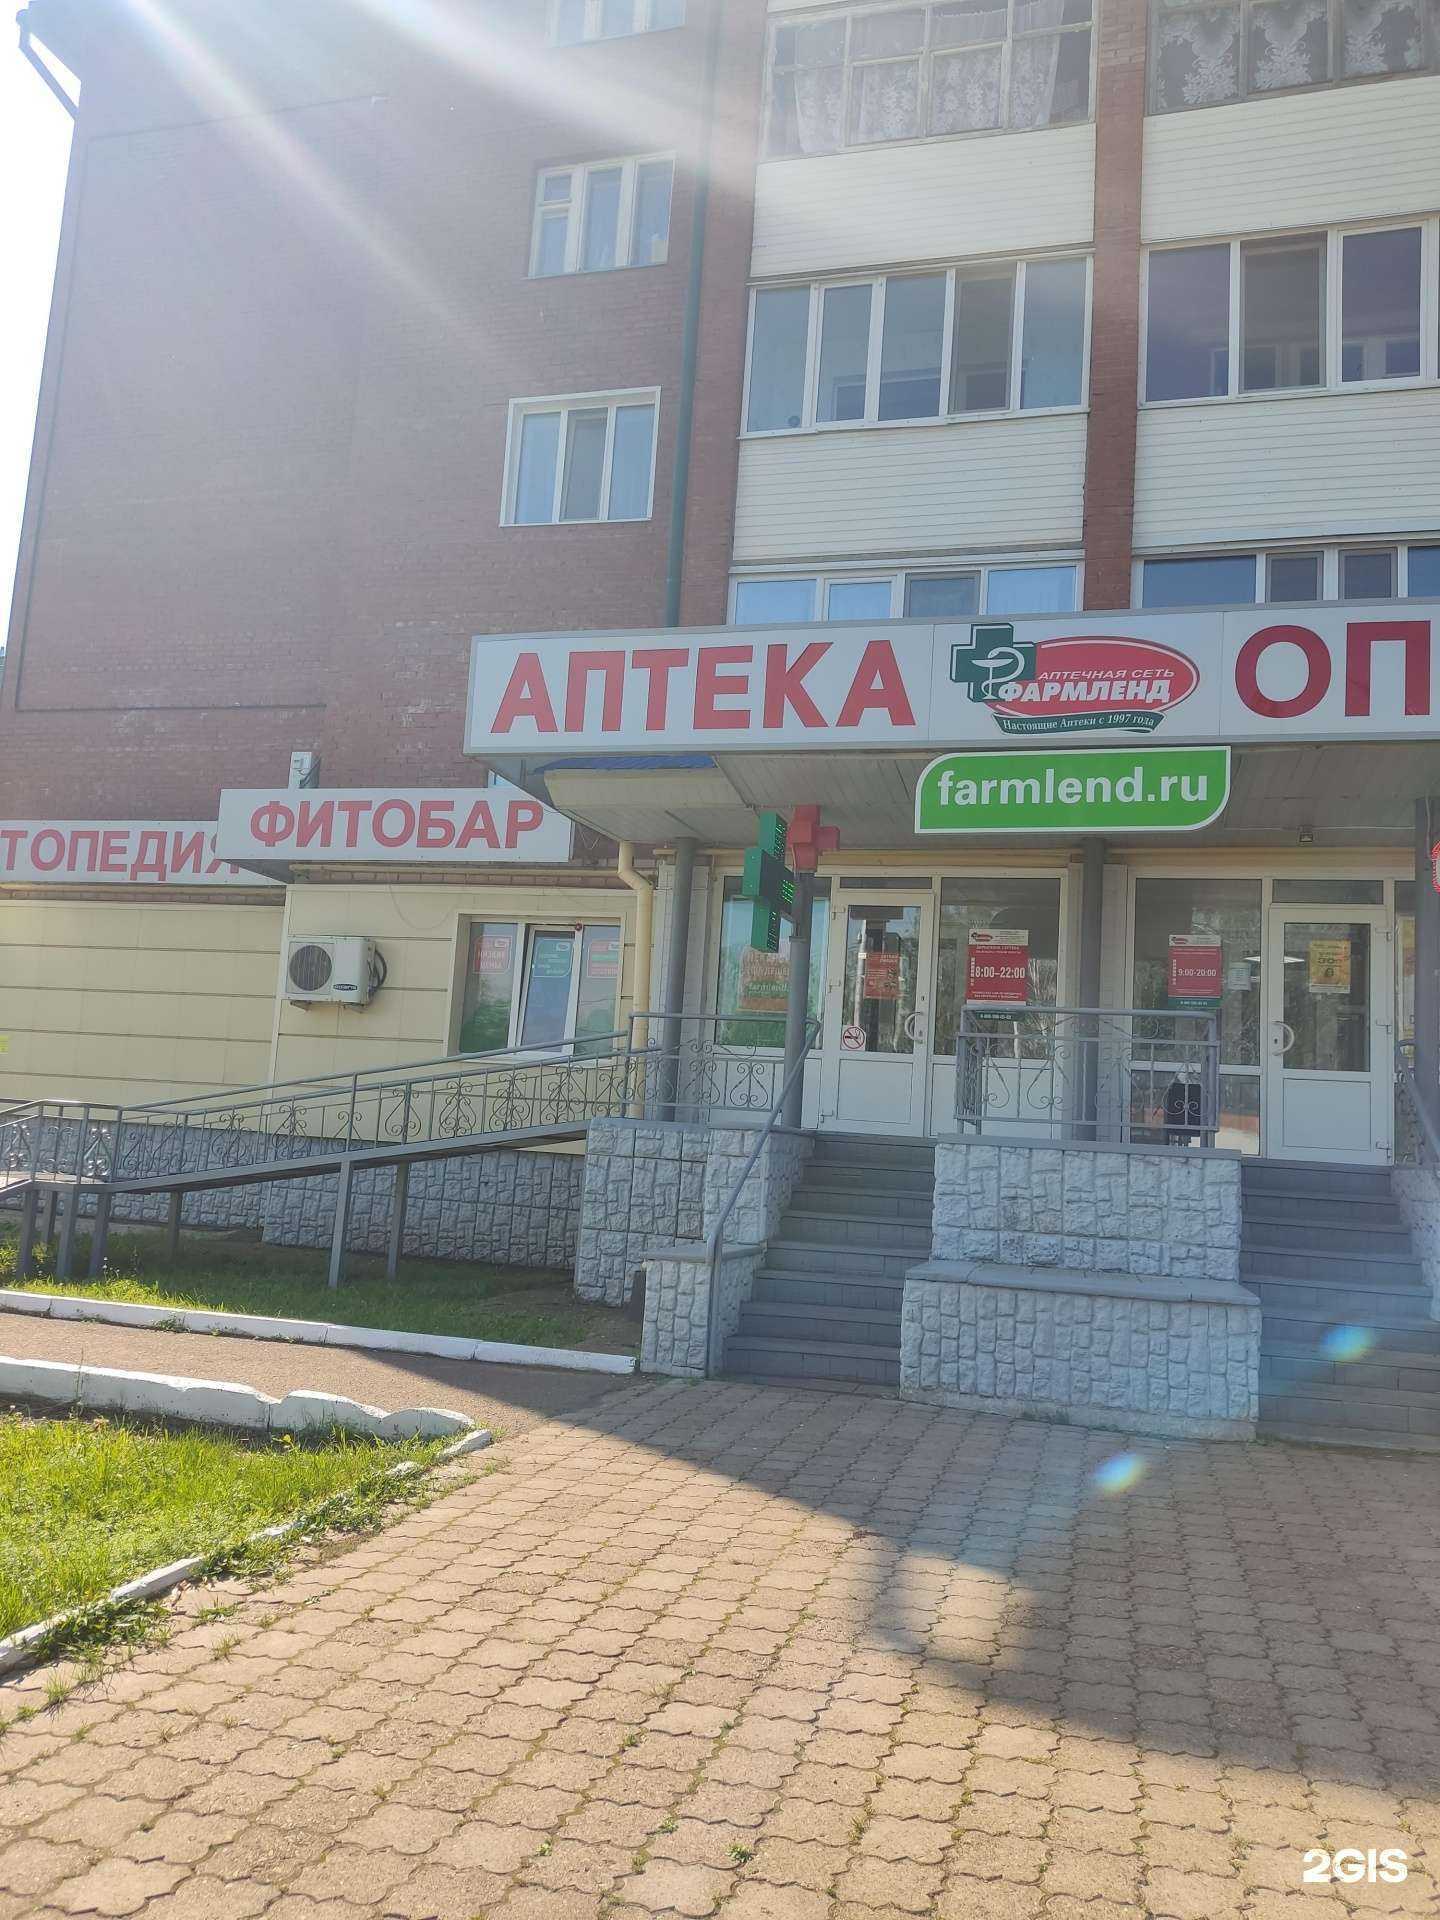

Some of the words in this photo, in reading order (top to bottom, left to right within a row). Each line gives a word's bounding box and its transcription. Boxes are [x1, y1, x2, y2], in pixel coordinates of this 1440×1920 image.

[490, 640, 916, 733] АПТЕКА
[1038, 670, 1128, 681] АПТЕЧНАЯ
[1131, 669, 1175, 679] СЕТЬ
[998, 680, 1172, 703] ФАРМЛЕНД
[1002, 718, 1058, 732] Настоящие
[1060, 717, 1100, 728] Аптеки
[1108, 713, 1131, 724] 1997
[1132, 715, 1155, 727] года
[938, 766, 1208, 806] farmlend.ru
[250, 799, 544, 849] ФИТОБАР
